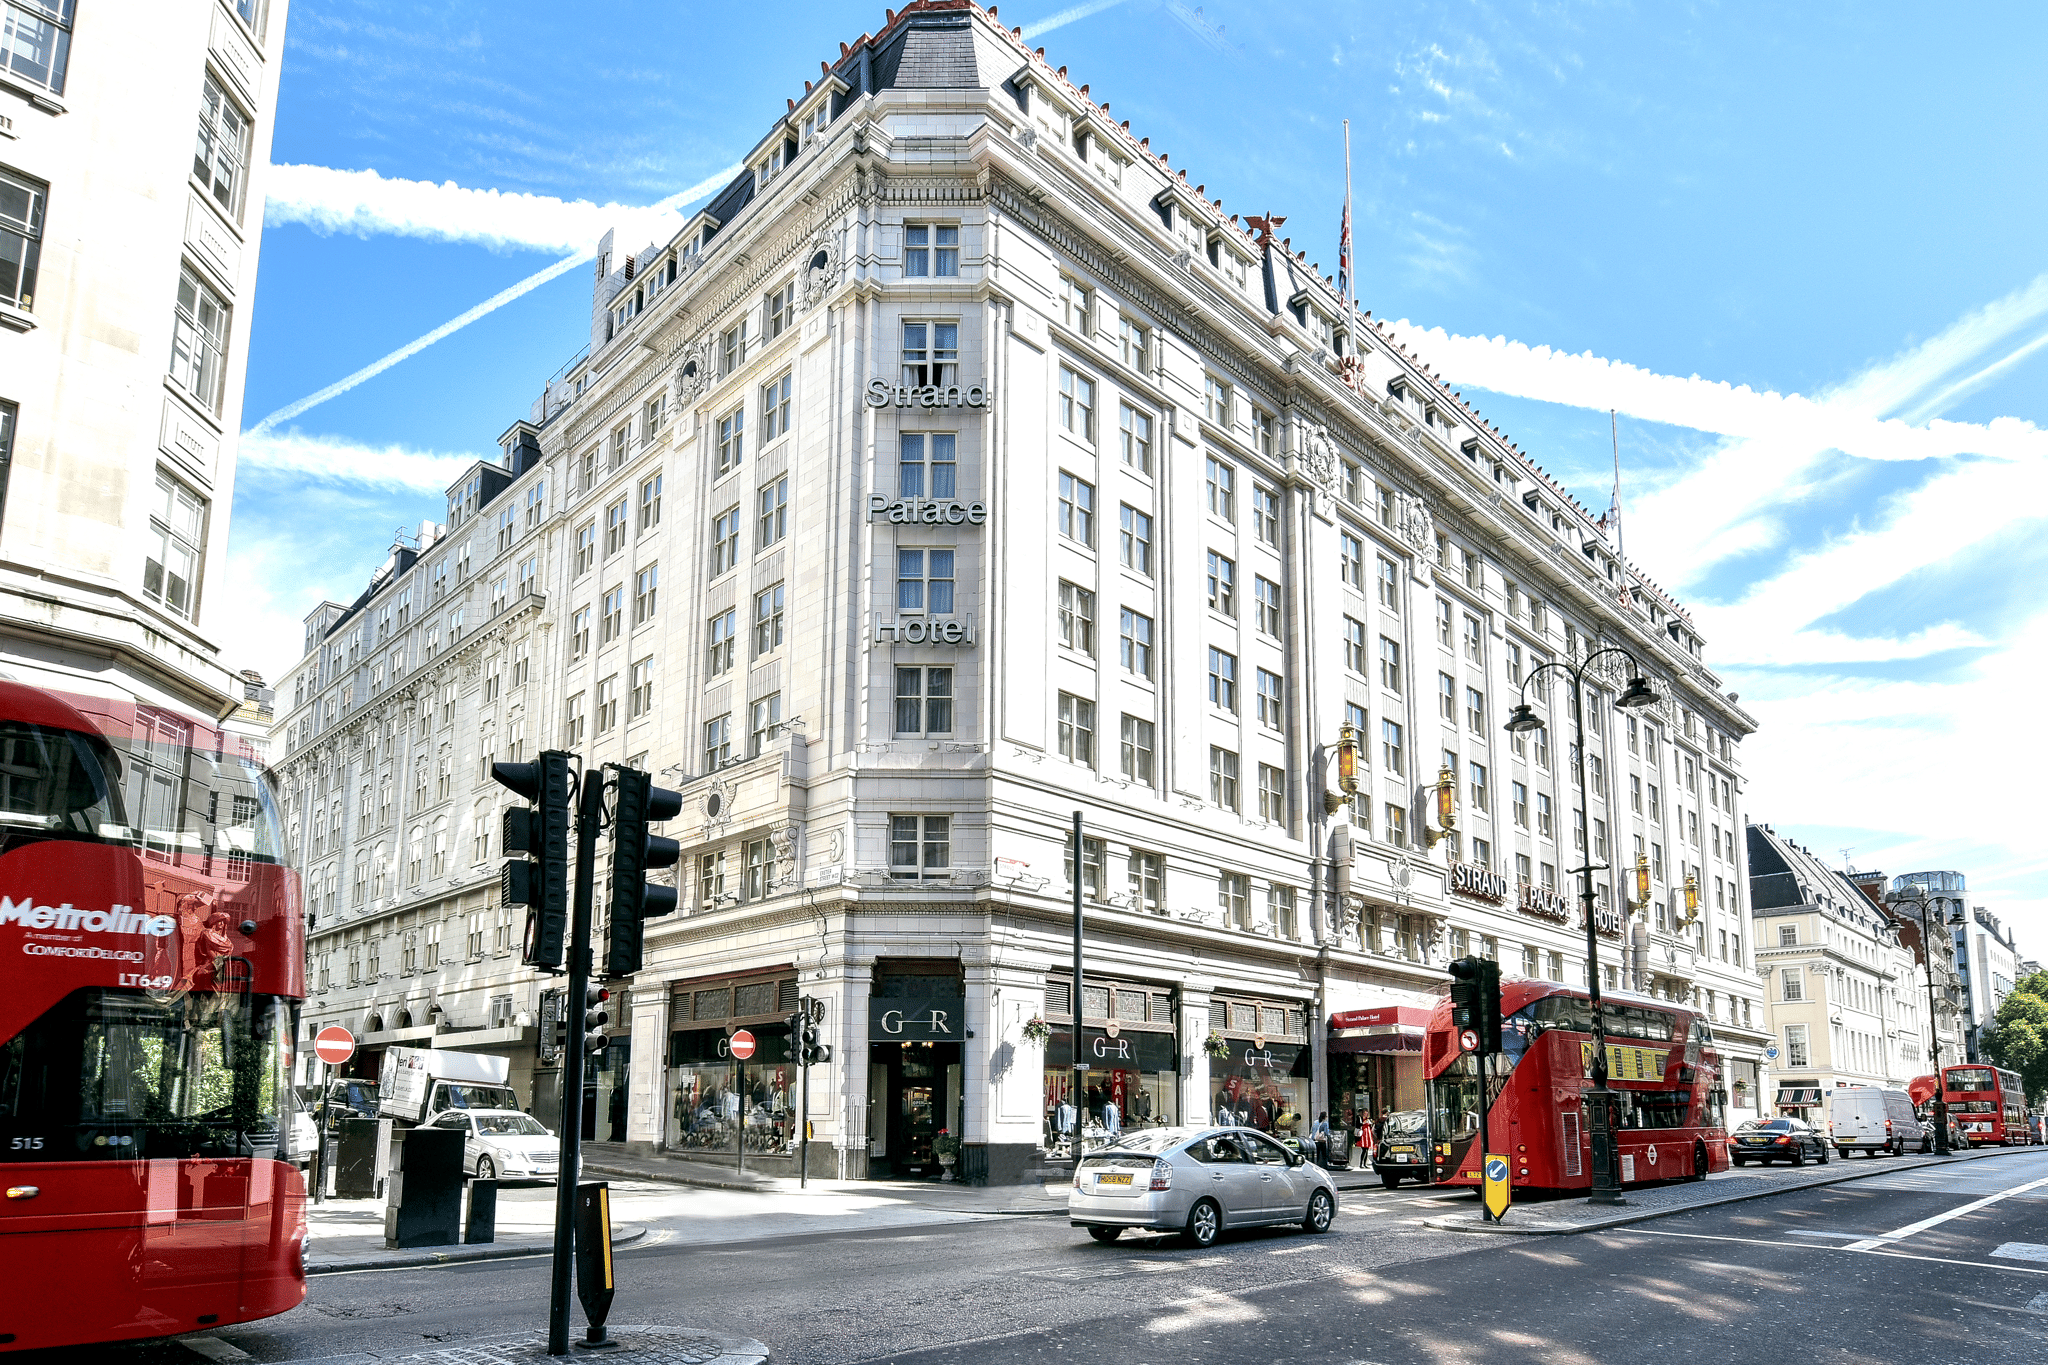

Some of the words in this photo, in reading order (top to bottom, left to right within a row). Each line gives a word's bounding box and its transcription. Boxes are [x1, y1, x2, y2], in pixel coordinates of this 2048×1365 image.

[865, 377, 988, 409] Strand
[866, 493, 988, 525] Palace
[875, 612, 975, 645] Hotel
[1456, 862, 1508, 898] STRAND
[1530, 887, 1571, 917] PALACE
[1593, 906, 1625, 935] HOTEL
[0, 895, 177, 937] Metroline
[118, 973, 173, 988] LT649
[9, 1137, 45, 1150] 515
